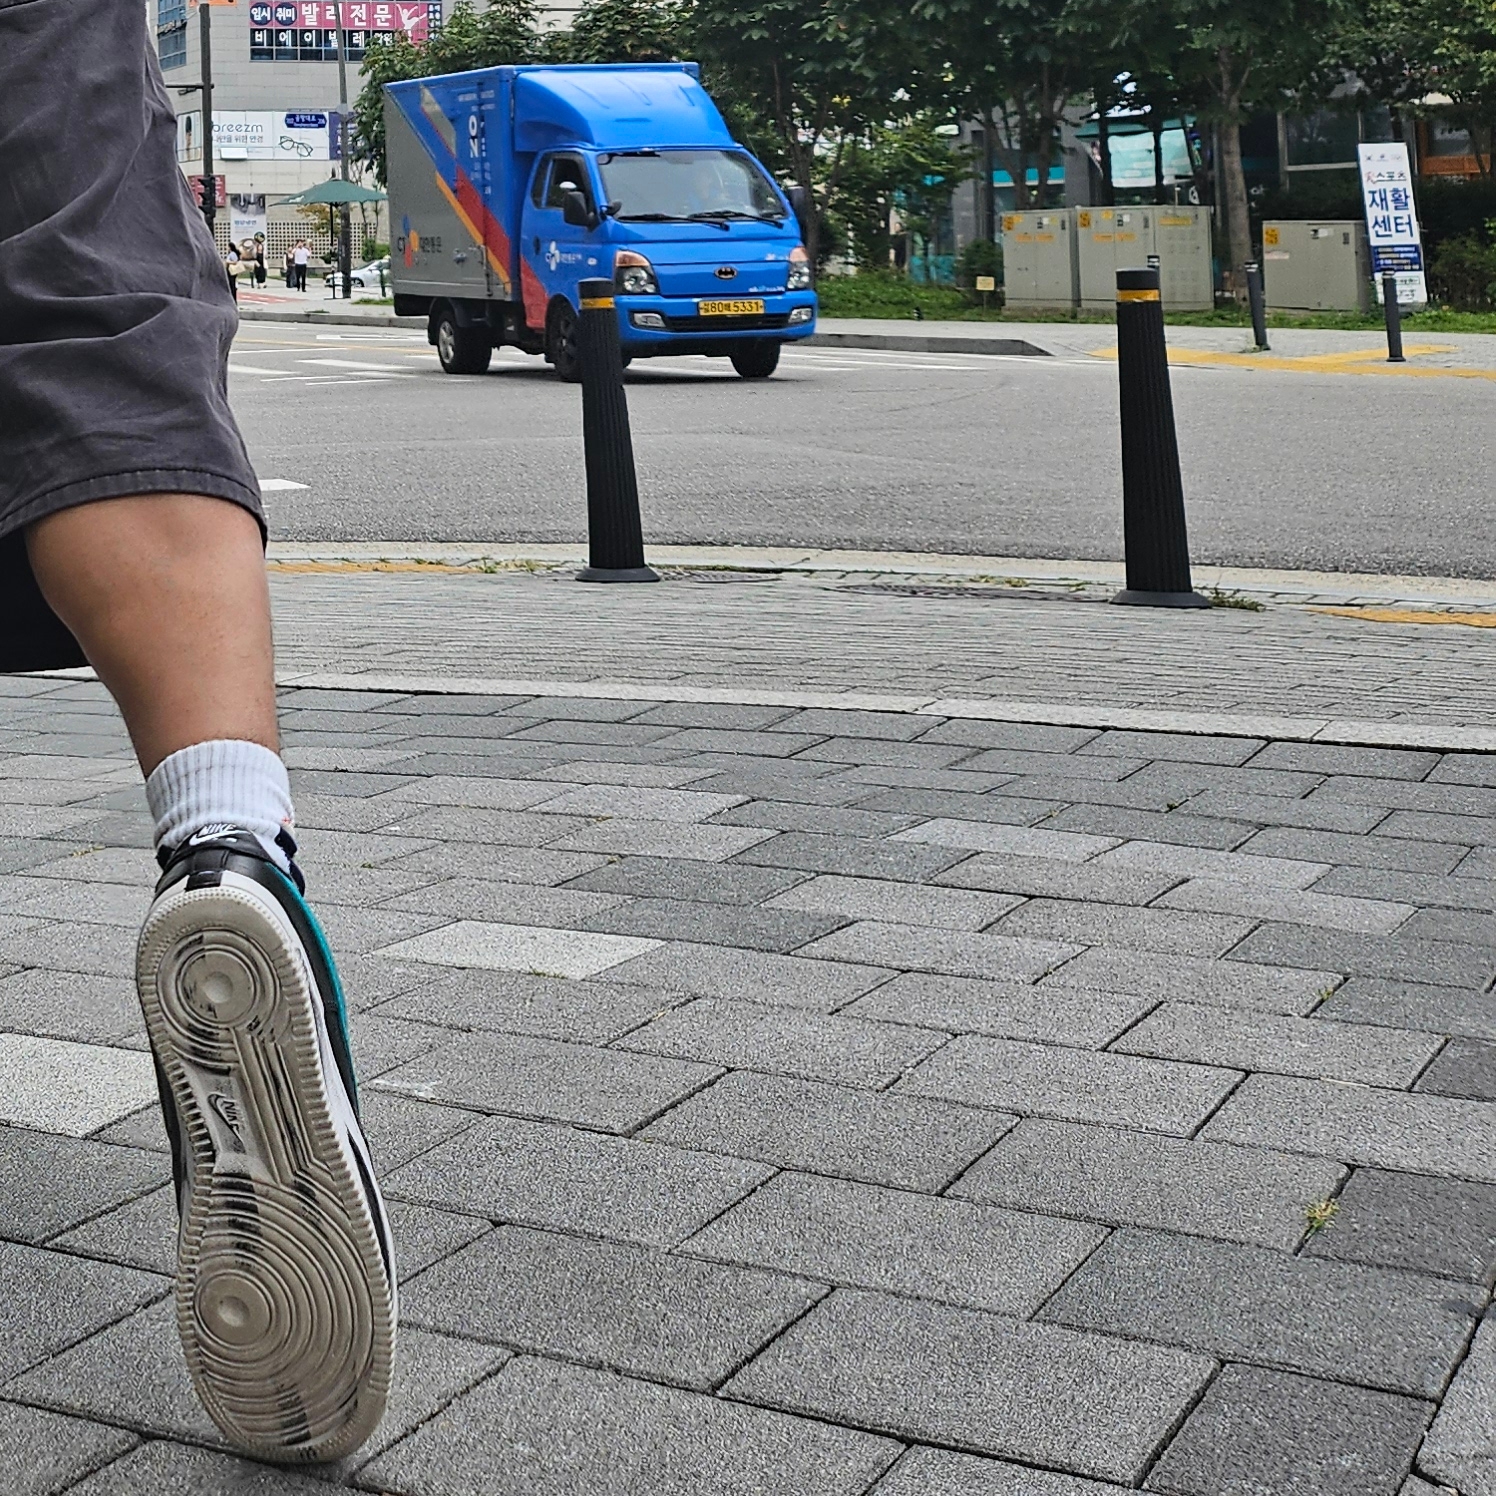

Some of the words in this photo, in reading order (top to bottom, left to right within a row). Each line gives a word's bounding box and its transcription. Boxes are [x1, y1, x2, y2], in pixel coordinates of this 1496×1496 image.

[251, 7, 271, 22] 입시
[275, 7, 295, 21] 취미
[1368, 187, 1410, 212] 재활
[1372, 214, 1413, 238] 센터
[733, 301, 759, 312] 5331
[197, 823, 237, 837] NIKE
